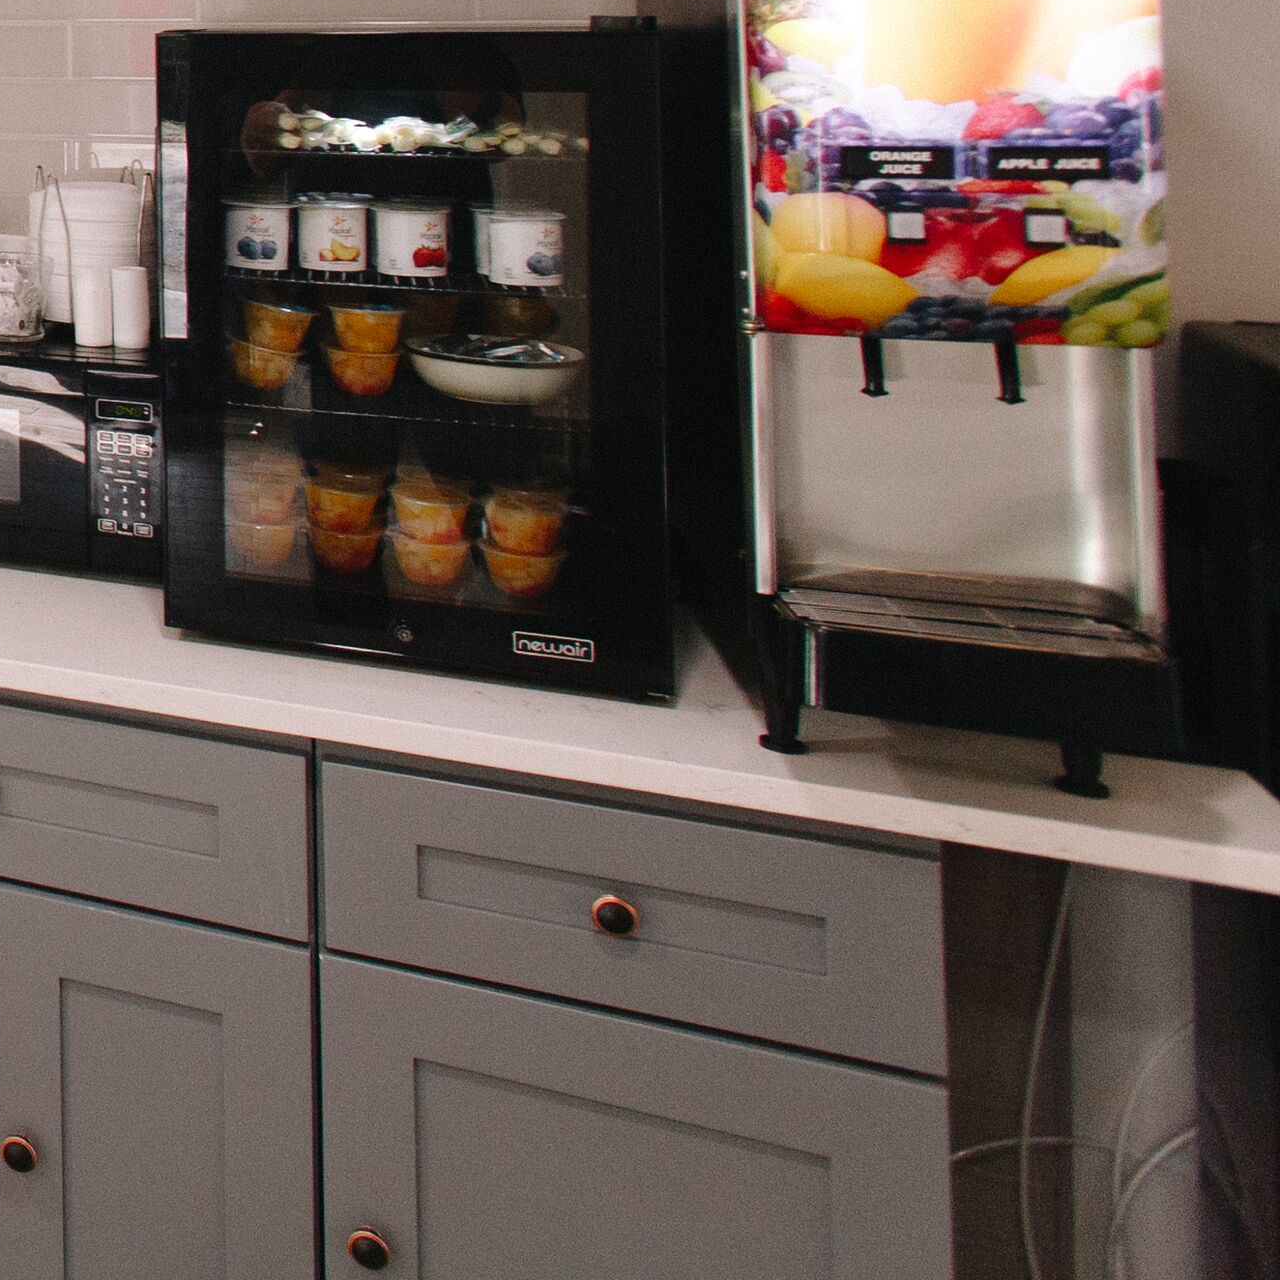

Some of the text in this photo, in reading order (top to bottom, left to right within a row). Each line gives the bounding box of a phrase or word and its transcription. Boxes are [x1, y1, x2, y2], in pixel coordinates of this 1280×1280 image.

[868, 151, 933, 162] ORANGE
[879, 164, 924, 175] JUICE
[997, 158, 1101, 170] APPLE JUICE
[518, 639, 589, 657] newair
